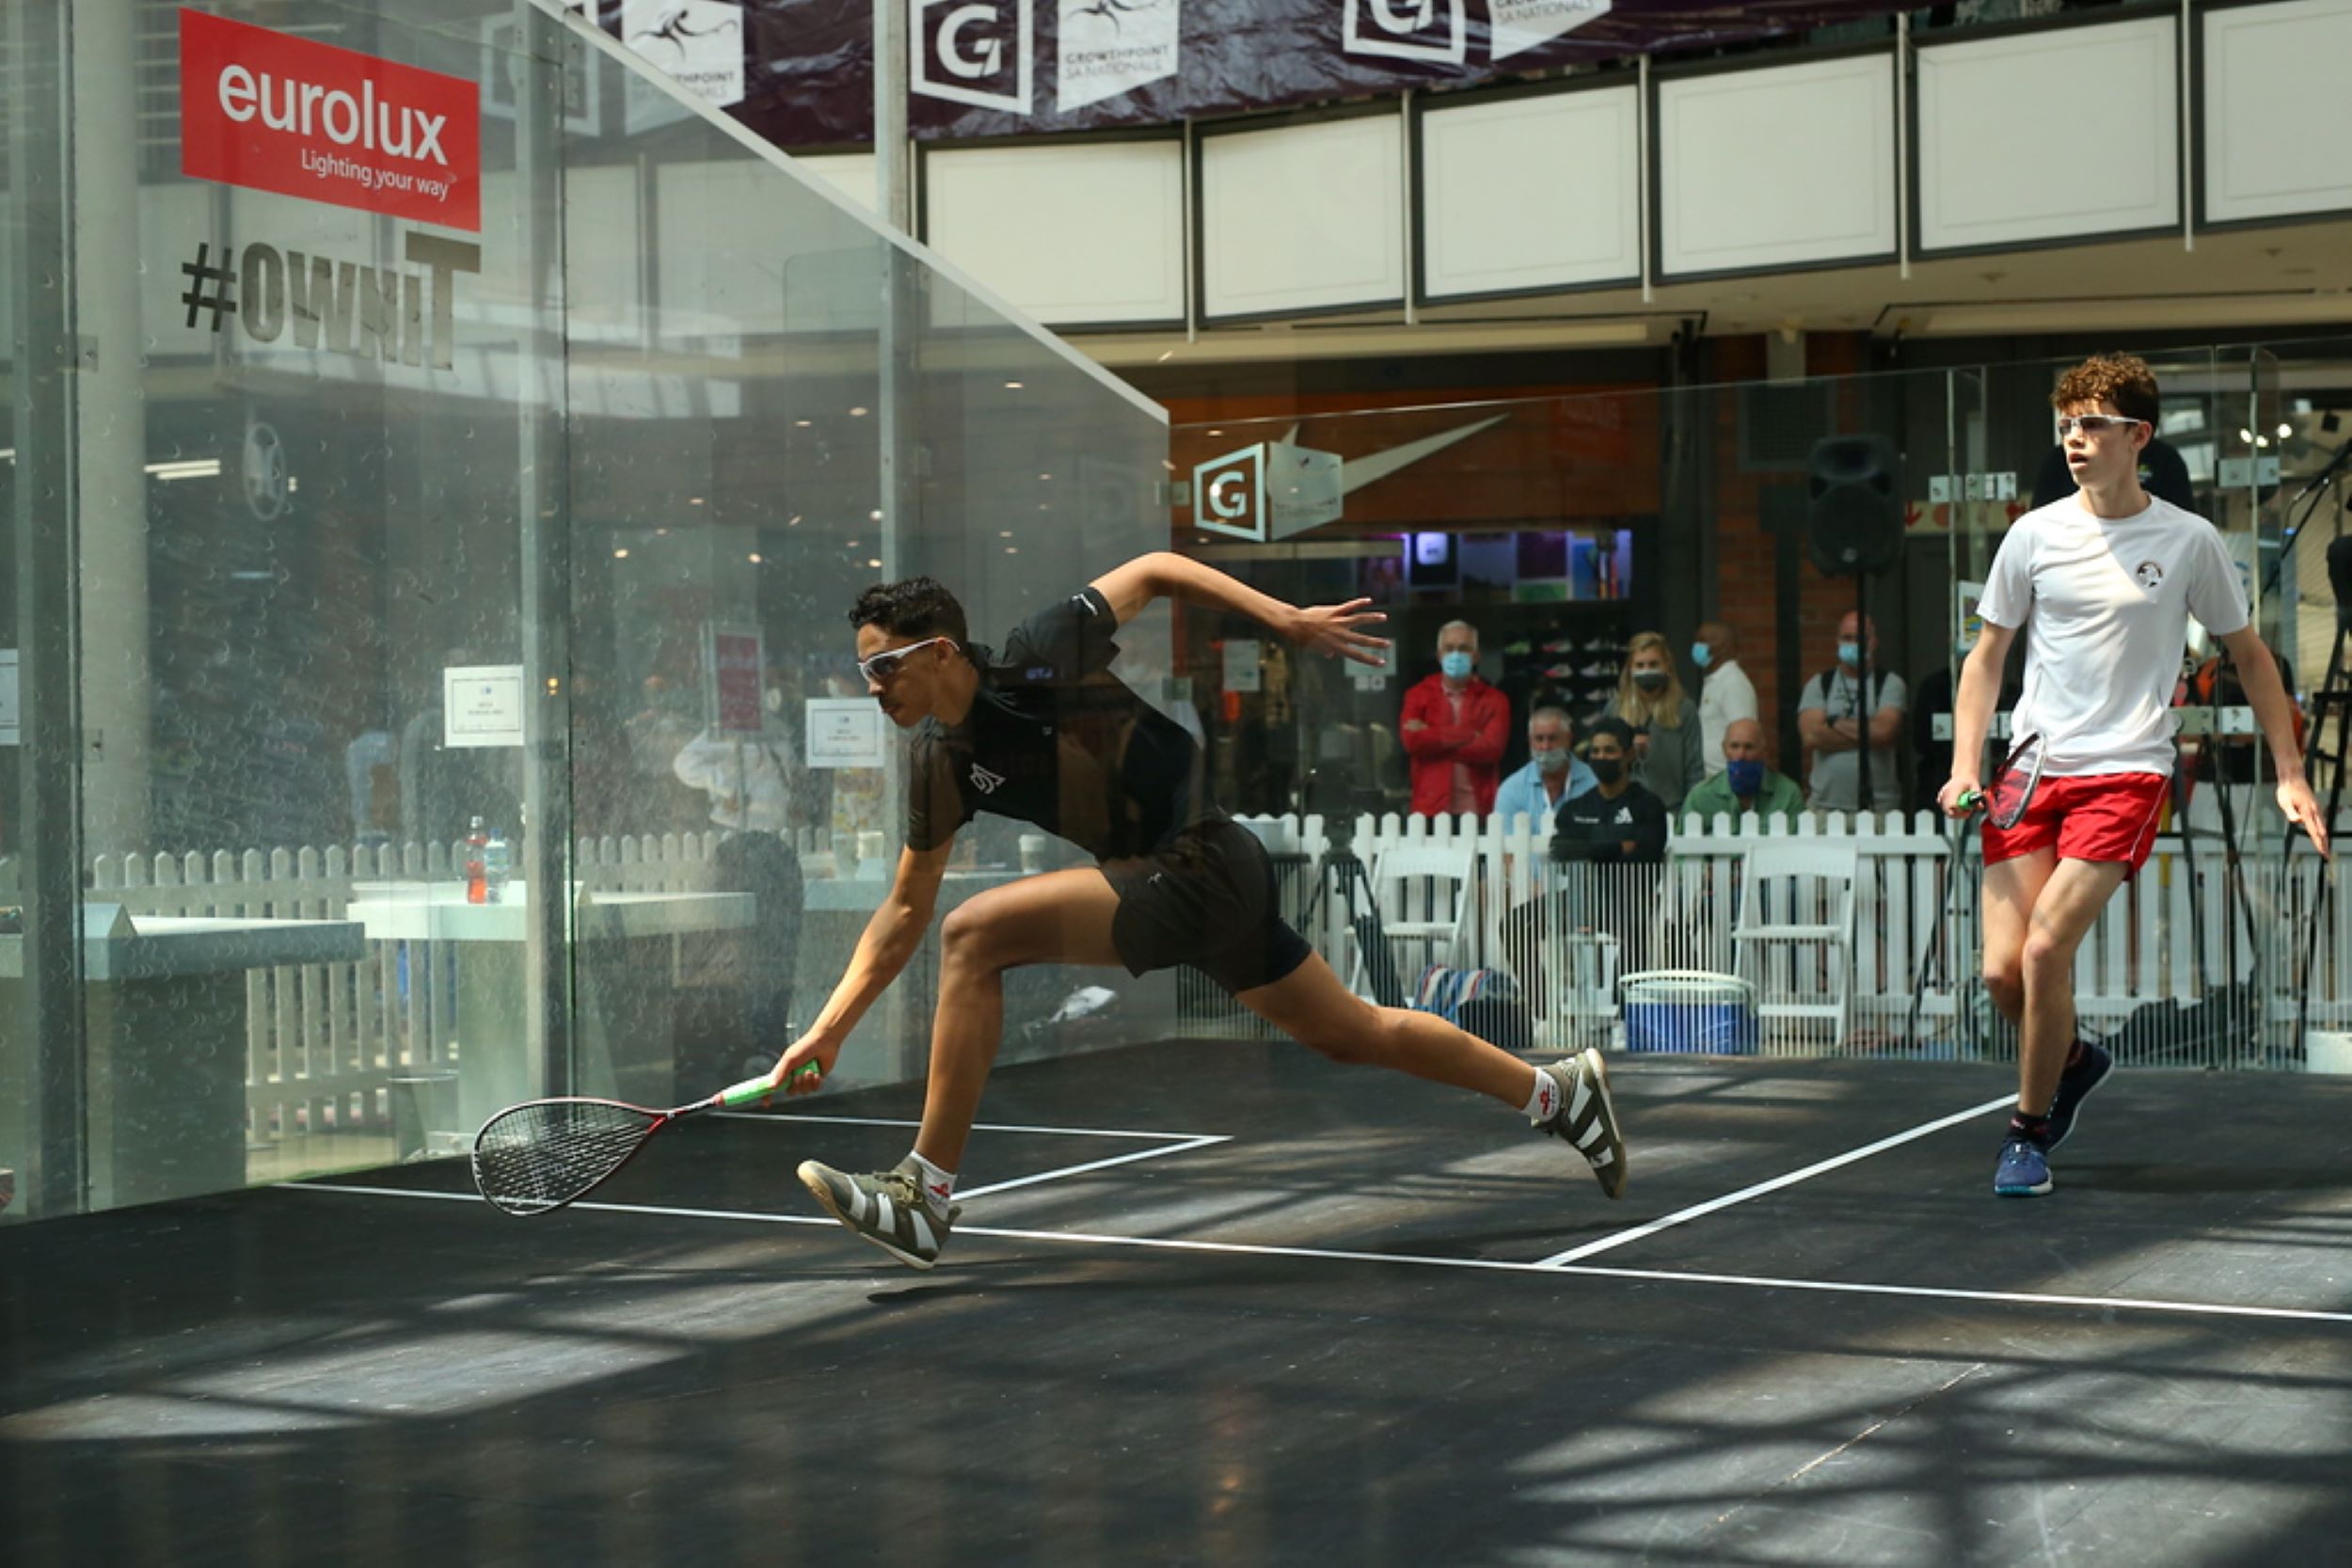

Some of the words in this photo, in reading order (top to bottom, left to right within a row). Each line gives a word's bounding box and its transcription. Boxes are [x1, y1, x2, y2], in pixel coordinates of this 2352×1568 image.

[935, 4, 1001, 79] G
[1065, 44, 1169, 65] GROWTHPOINT
[217, 63, 450, 166] eurolux
[301, 148, 373, 188] Lighting
[374, 167, 414, 190] your
[416, 176, 449, 202] way
[1209, 470, 1248, 518] G
